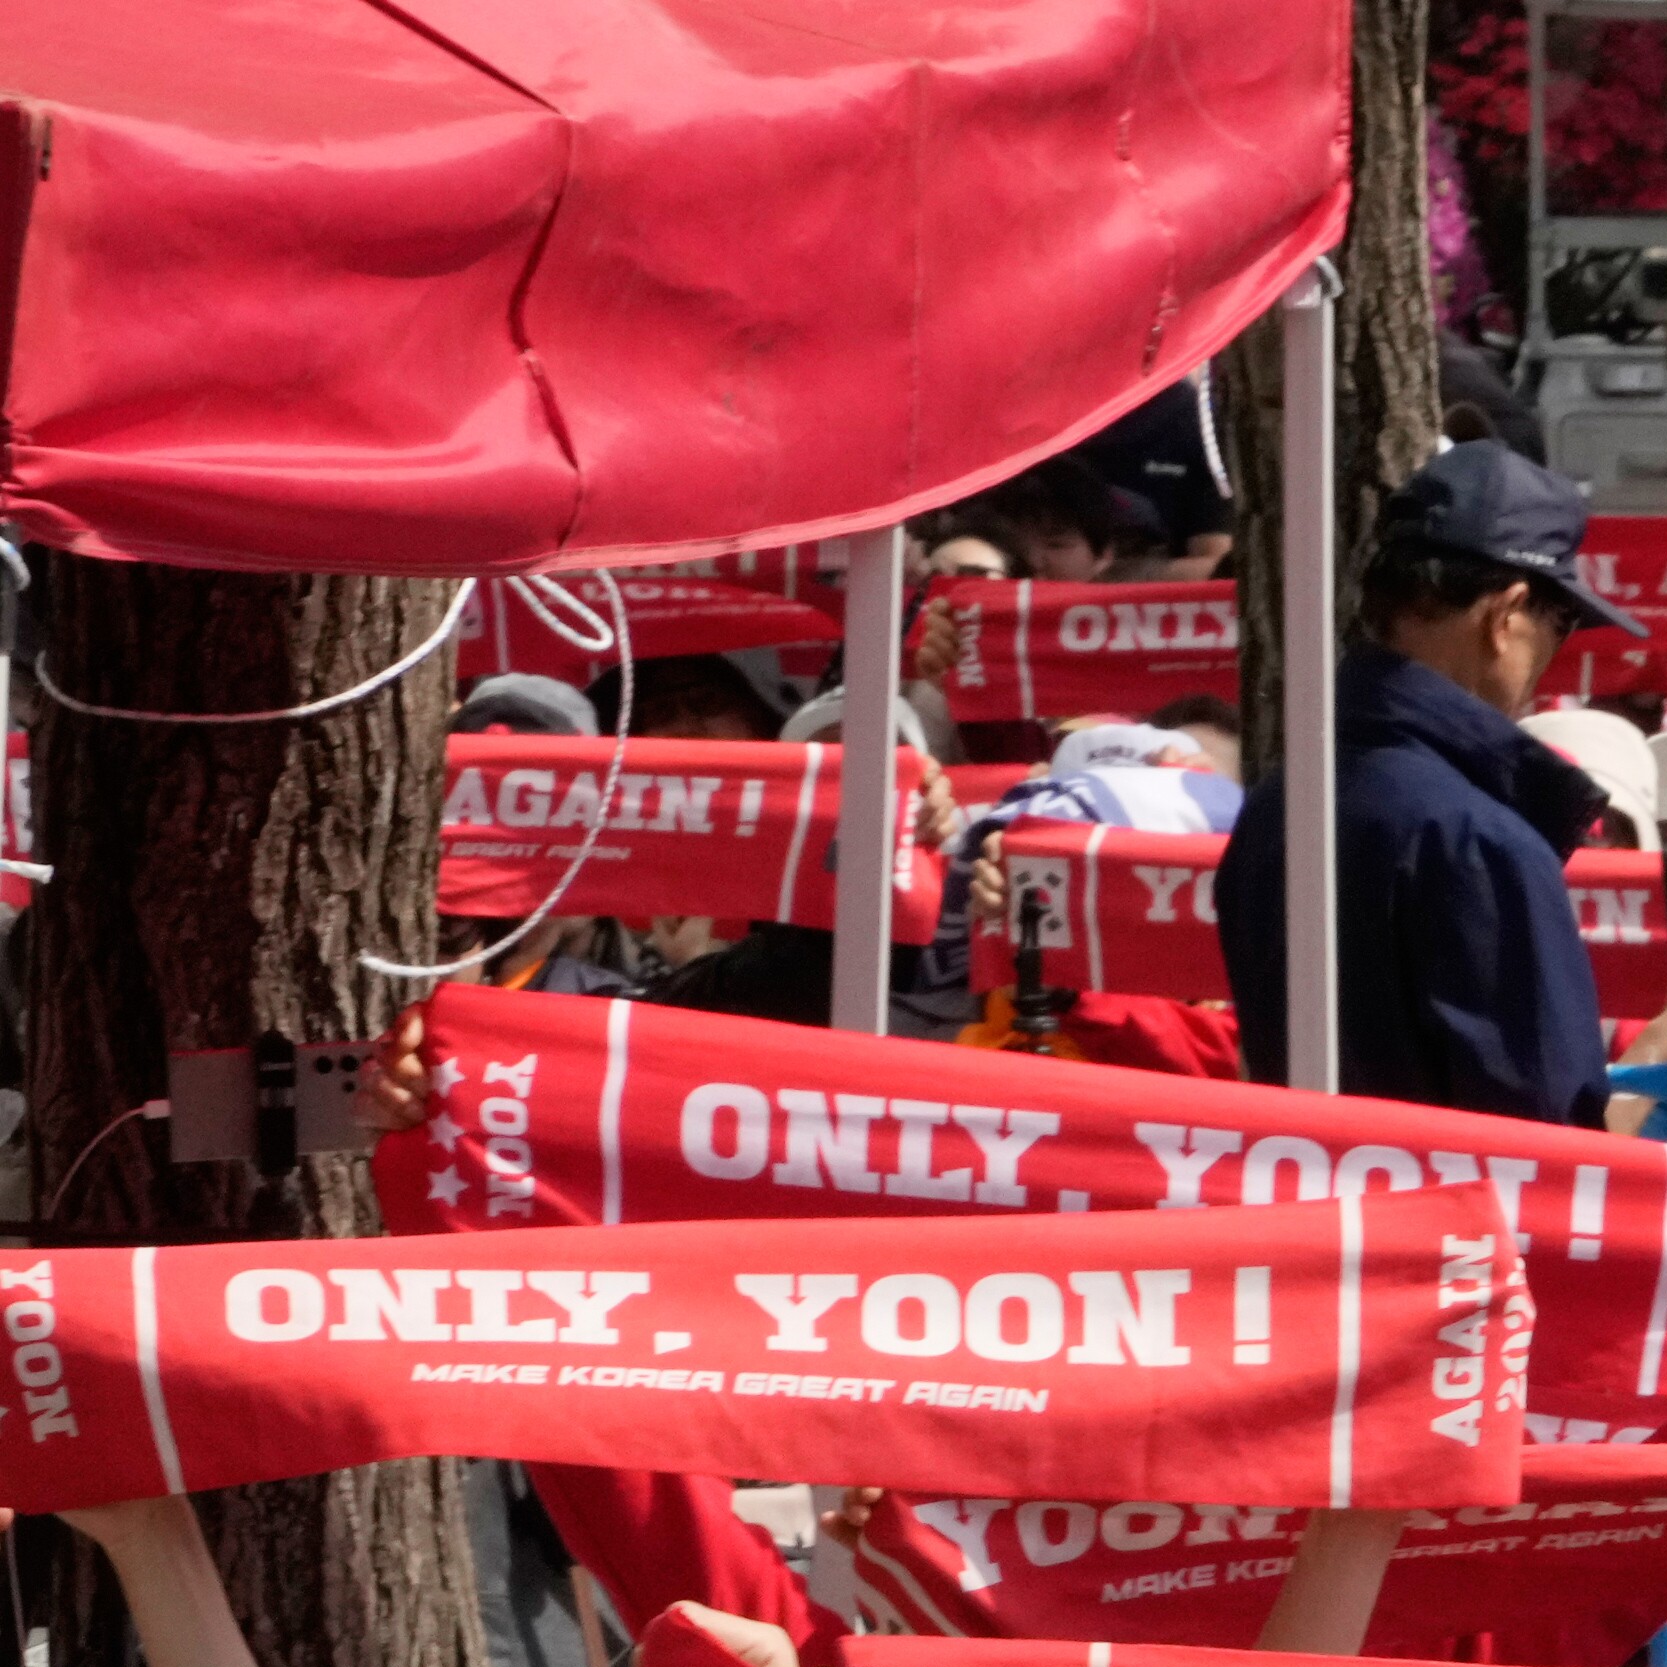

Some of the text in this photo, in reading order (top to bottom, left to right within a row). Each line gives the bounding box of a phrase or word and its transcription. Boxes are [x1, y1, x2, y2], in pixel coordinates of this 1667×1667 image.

[441, 766, 723, 835] AGAIN
[479, 1053, 538, 1218] YOON
[678, 1081, 1090, 1213] ONLY,
[0, 1259, 79, 1444] YOON
[224, 1268, 692, 1354] ONLY,
[734, 1268, 1191, 1368] YOON
[1430, 1234, 1496, 1447] AGAIN
[411, 1363, 1049, 1413] MAKE KOREA GREAT AGAIN
[1103, 1563, 1218, 1601] MAKE
